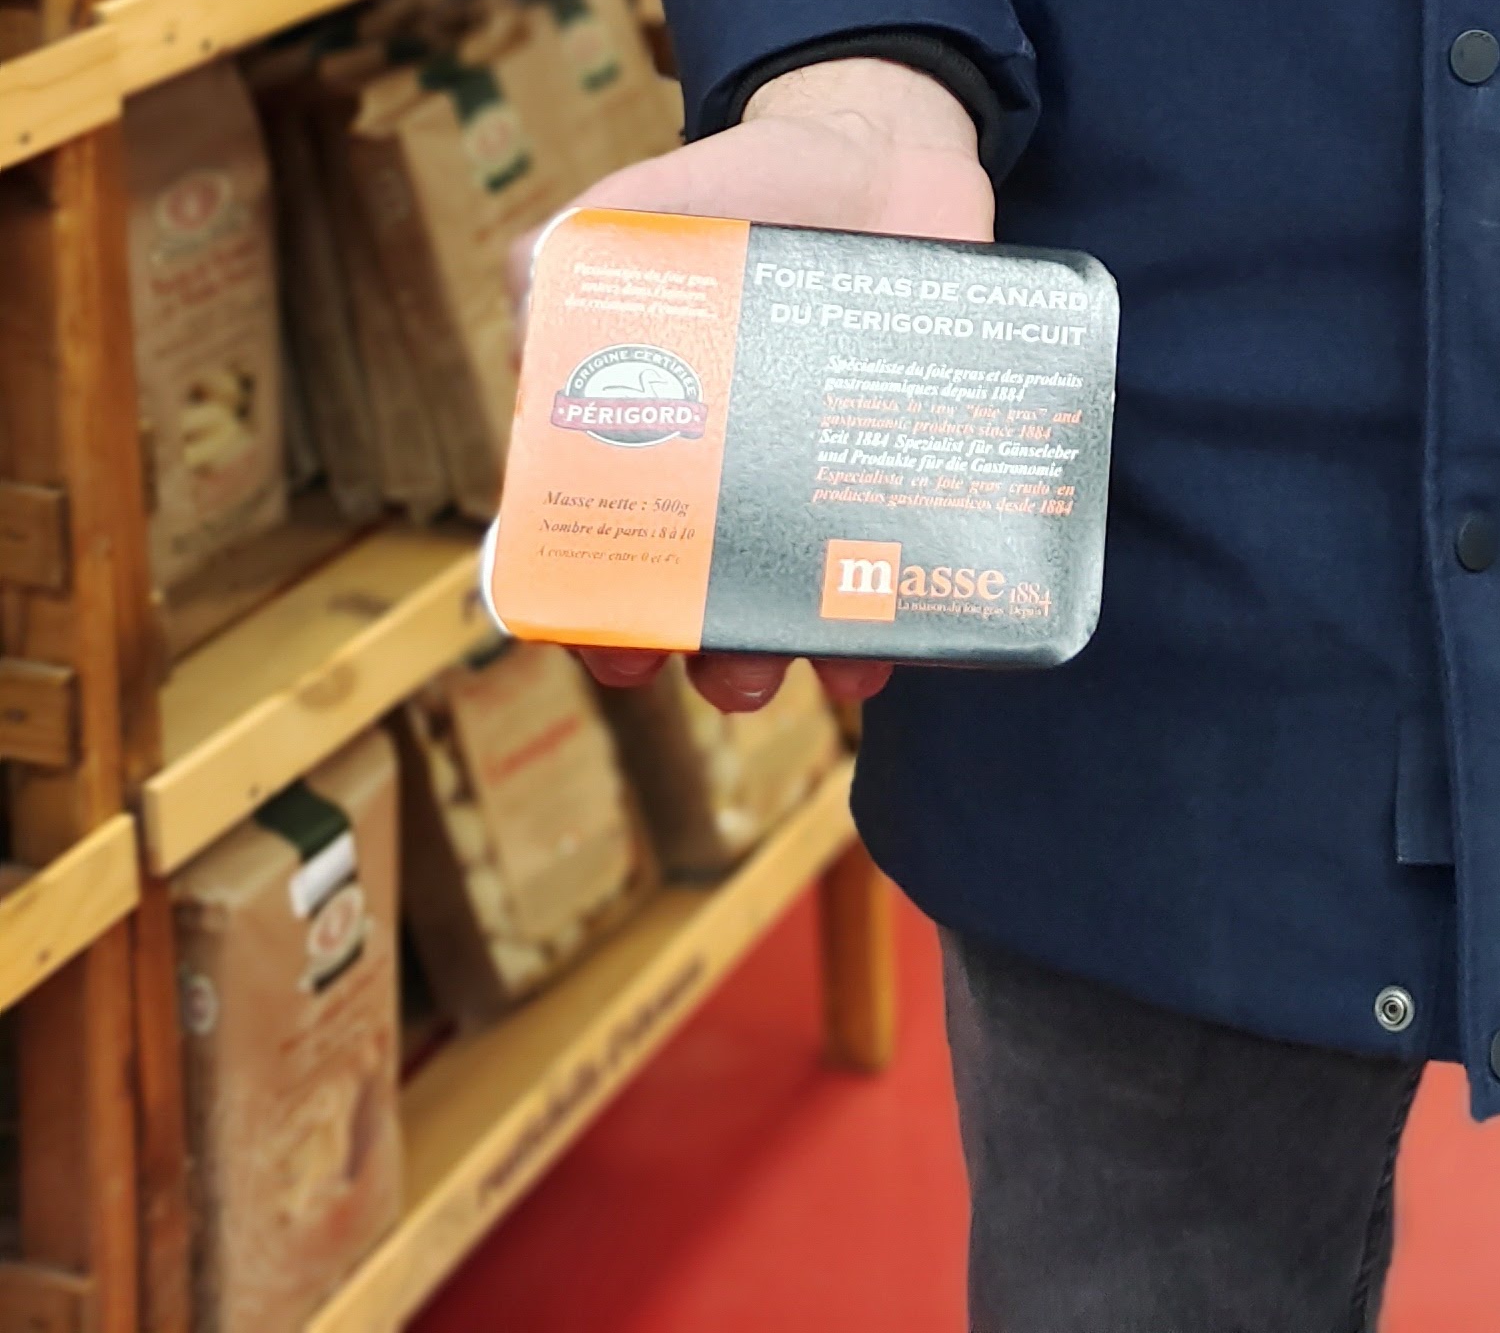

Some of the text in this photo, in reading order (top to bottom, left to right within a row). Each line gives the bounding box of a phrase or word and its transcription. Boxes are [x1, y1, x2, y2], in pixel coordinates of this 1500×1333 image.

[755, 262, 1088, 312] FOIE GRAS DE CANARD
[770, 302, 1087, 346] DU PERIGORD MI-CUIT
[574, 350, 629, 390] ORIGINE
[905, 361, 924, 377] du
[923, 363, 953, 381] foie
[953, 369, 985, 383] gras
[986, 369, 1000, 382] et
[1000, 369, 1024, 383] des
[1024, 372, 1083, 388] produits
[824, 377, 1025, 402] gastronomiques depuis 1884
[566, 401, 693, 424] PÉRIGORD
[1053, 410, 1082, 424] and
[819, 428, 1079, 460] Seit 1884 Spezialist für Gänseleber
[1019, 424, 1052, 440] 1884
[817, 449, 1063, 477] und Produkte für die Gastronomie
[543, 490, 594, 509] Masse
[598, 497, 637, 511] nette
[653, 497, 689, 517] 500g
[1057, 485, 1075, 497] en
[1040, 499, 1074, 516] 1884
[539, 518, 593, 535] Nombre
[597, 522, 611, 536] de
[613, 526, 648, 539] parts
[680, 527, 696, 541] 10
[608, 550, 638, 562] entre
[836, 557, 1006, 600] masse
[1010, 582, 1052, 617] 1884
